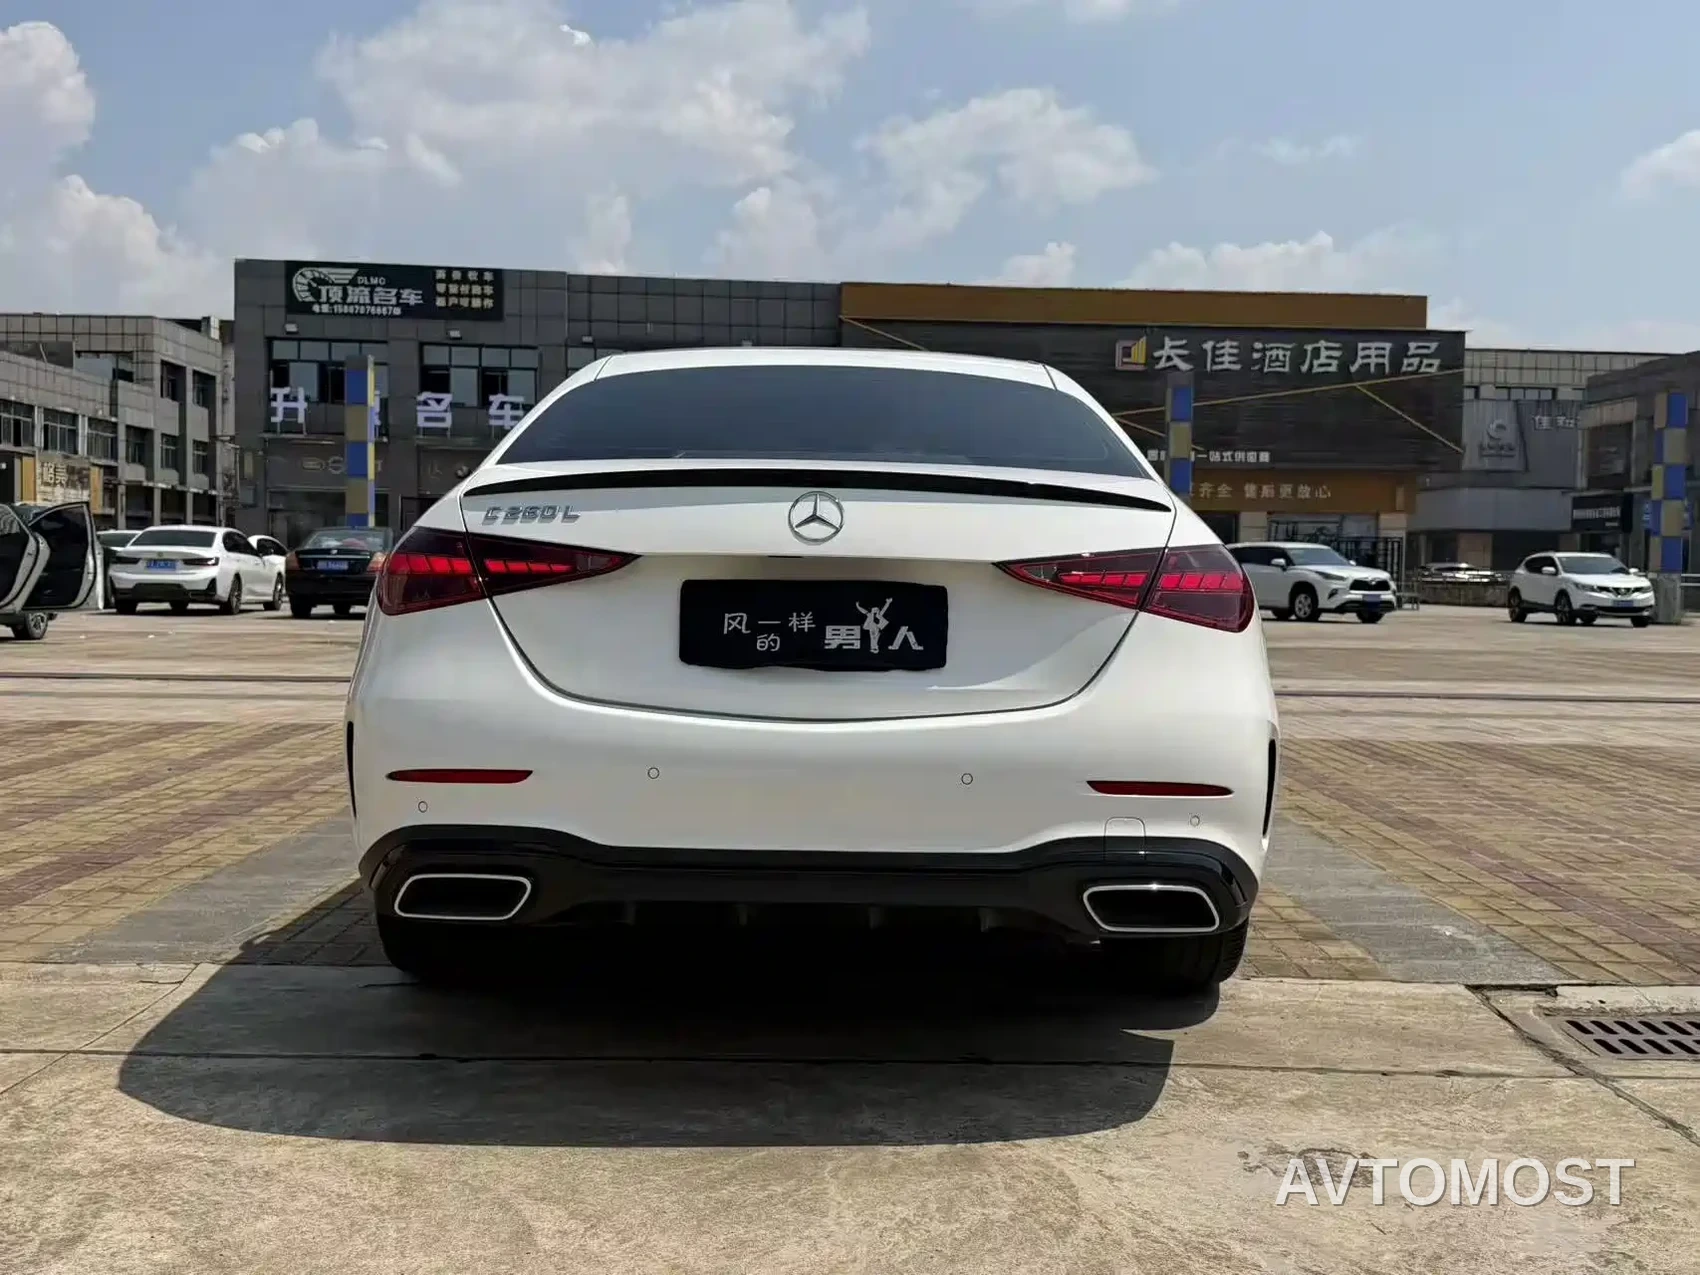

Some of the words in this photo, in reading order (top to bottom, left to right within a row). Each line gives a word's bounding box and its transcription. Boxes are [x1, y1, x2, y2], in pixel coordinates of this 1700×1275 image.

[1152, 335, 1442, 374] 长佳酒店用品
[270, 386, 525, 429] 升名车
[723, 612, 816, 635] 风一样
[756, 633, 781, 651] 的
